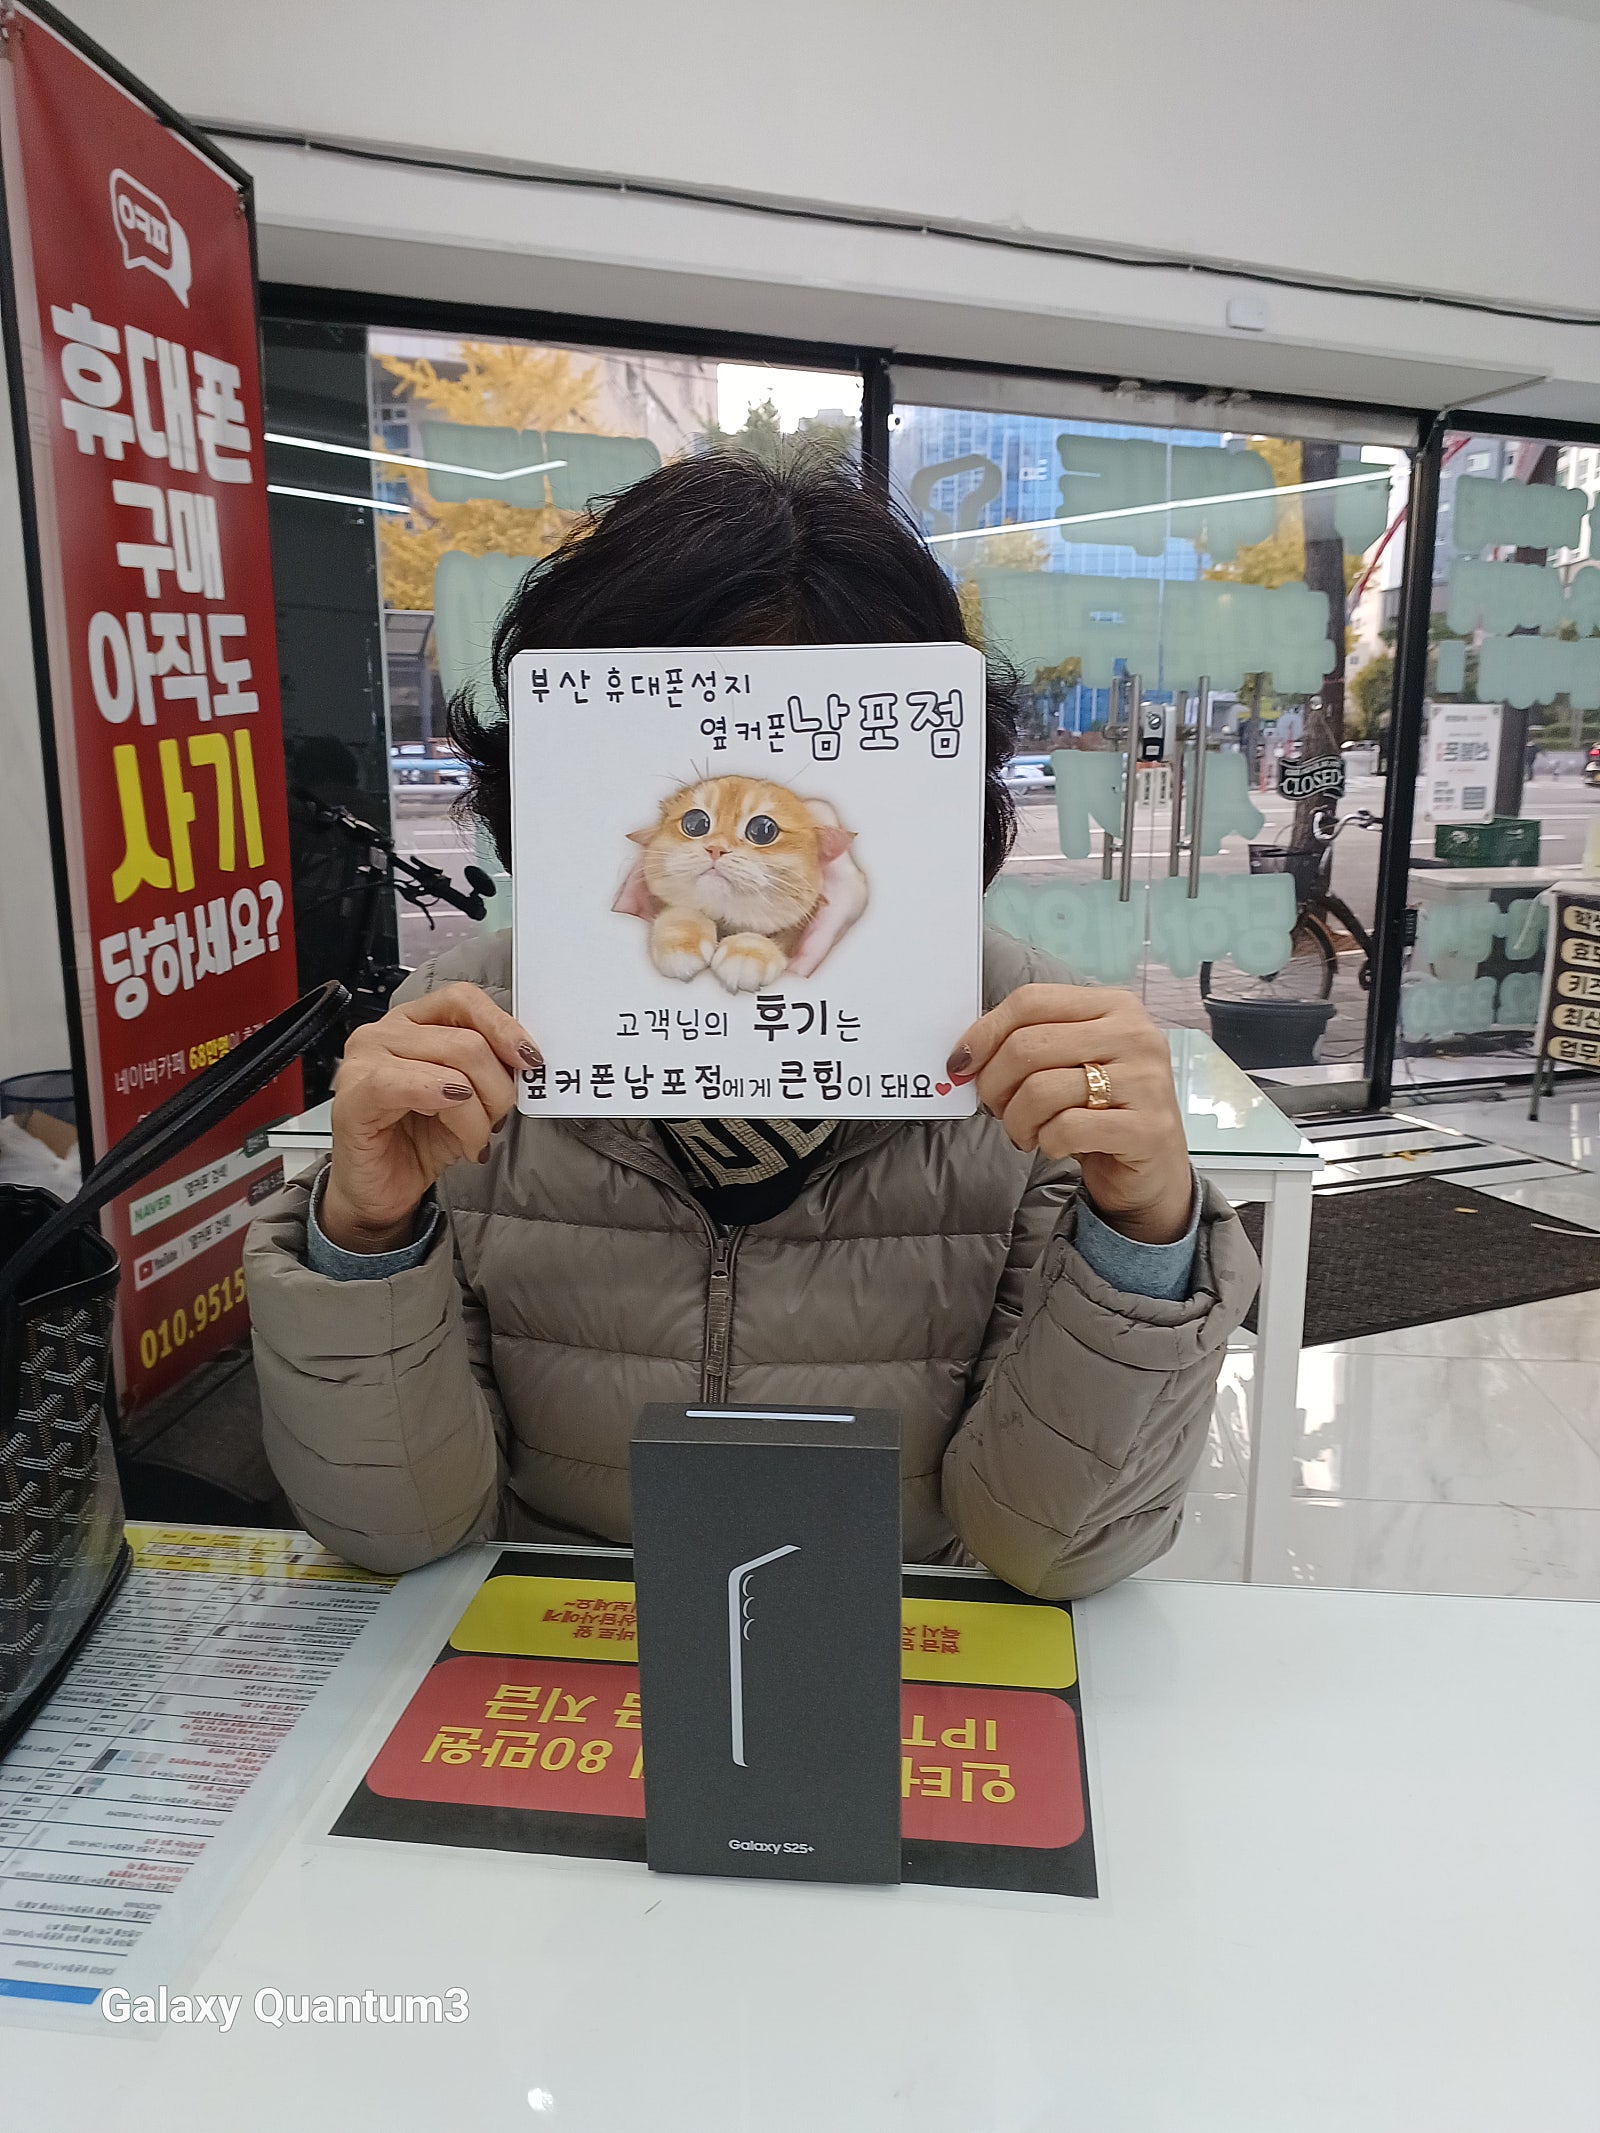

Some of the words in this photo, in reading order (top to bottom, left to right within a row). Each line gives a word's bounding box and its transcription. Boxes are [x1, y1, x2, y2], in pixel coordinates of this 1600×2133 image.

[50, 303, 253, 485] 휴대폰
[112, 479, 225, 600] 구매
[87, 611, 259, 726] 아직도
[530, 668, 591, 703] 부산
[605, 666, 752, 708] 휴대폰성지
[1280, 769, 1343, 795] CLOSED
[111, 728, 265, 903] 사기
[99, 879, 284, 1020] 당하세요?
[616, 1009, 728, 1042] 고객님의
[753, 994, 862, 1043] 후기는
[114, 1050, 187, 1094] 네이버카페
[1560, 1040, 1600, 1062] 업무
[880, 1072, 934, 1100] 돼요
[563, 1598, 637, 1613] 보세요~
[484, 1684, 598, 1723] 지급
[421, 1725, 613, 1774] 80만원
[728, 1839, 782, 1855] Galaxy
[782, 1842, 815, 1854] S25+
